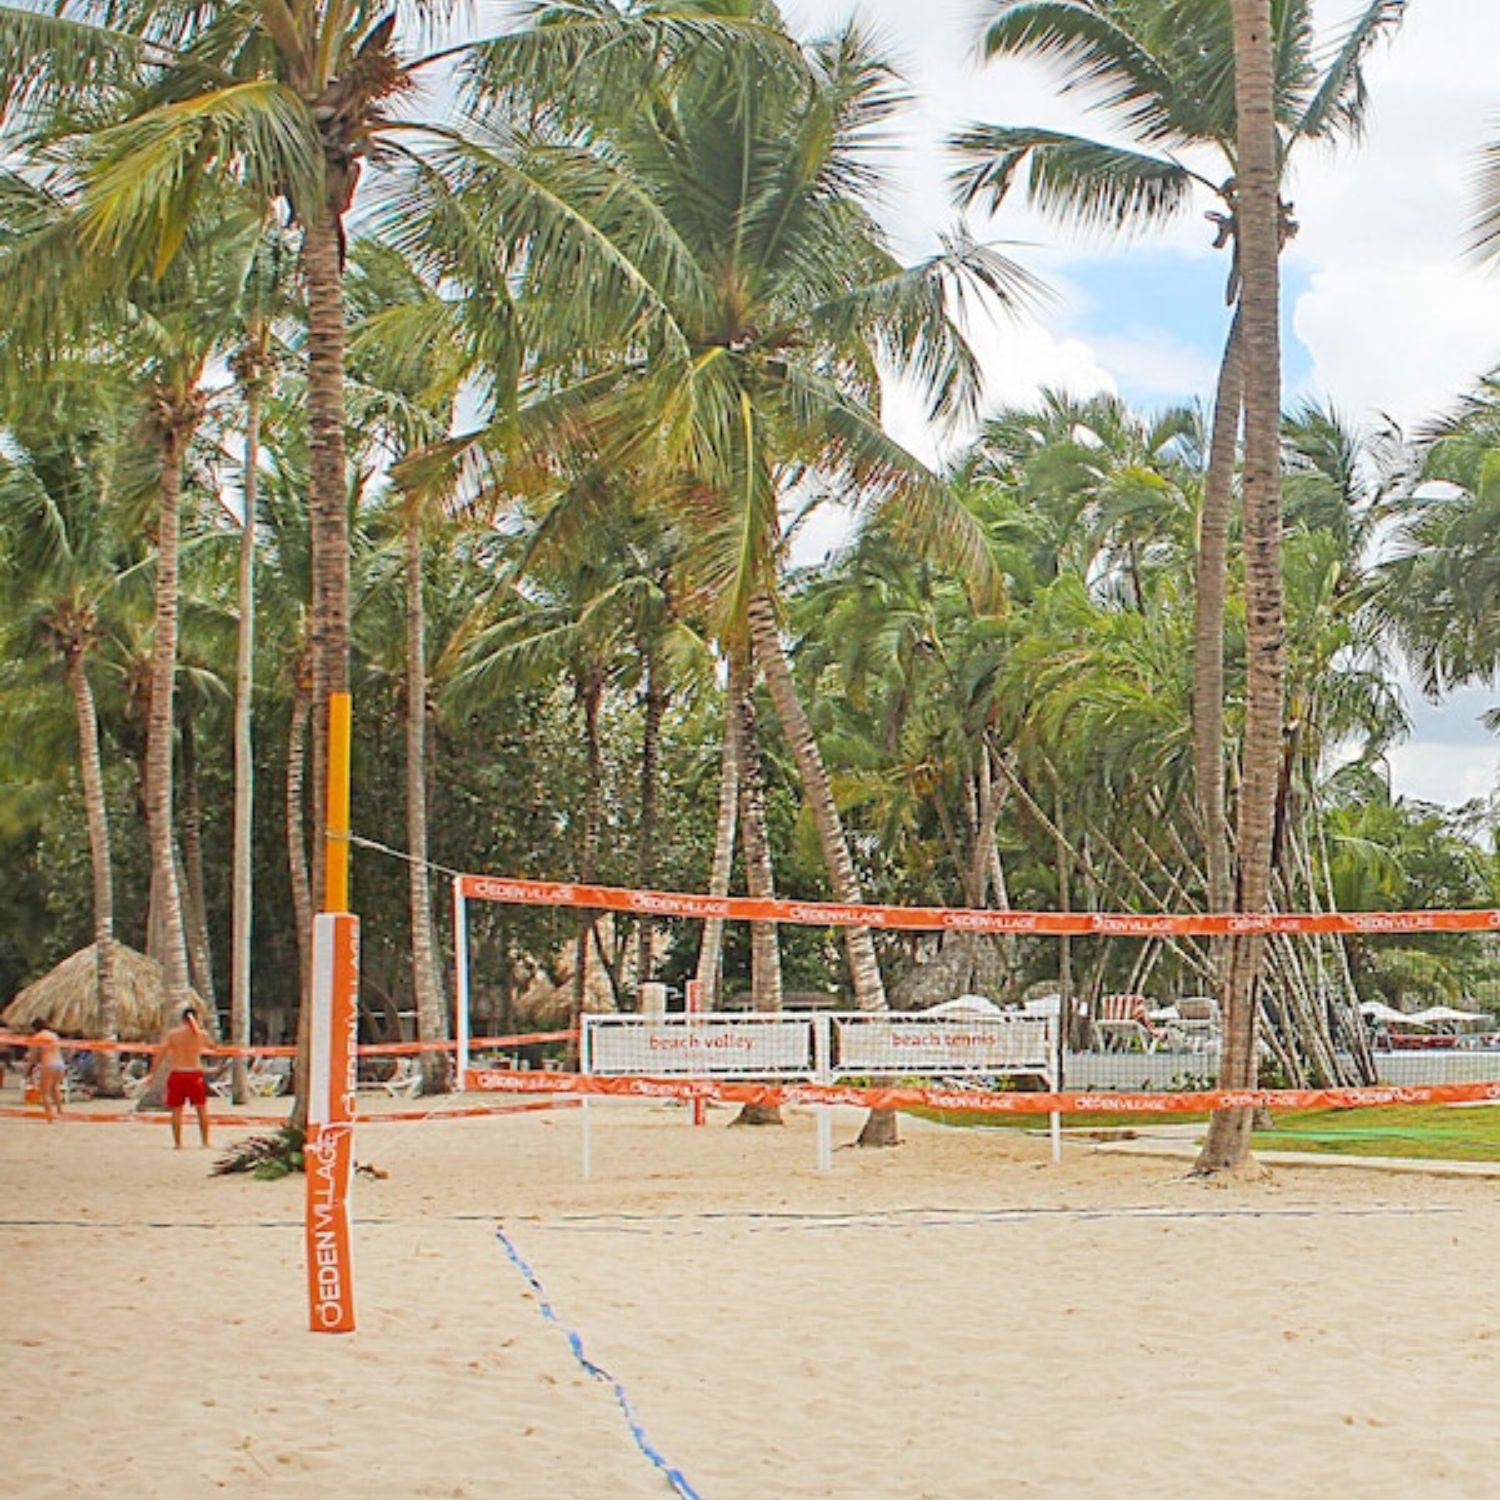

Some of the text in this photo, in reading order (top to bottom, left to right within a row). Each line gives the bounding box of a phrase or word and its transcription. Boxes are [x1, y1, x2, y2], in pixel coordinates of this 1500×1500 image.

[649, 1033, 754, 1050] beach volley
[891, 1031, 996, 1047] beach tennis
